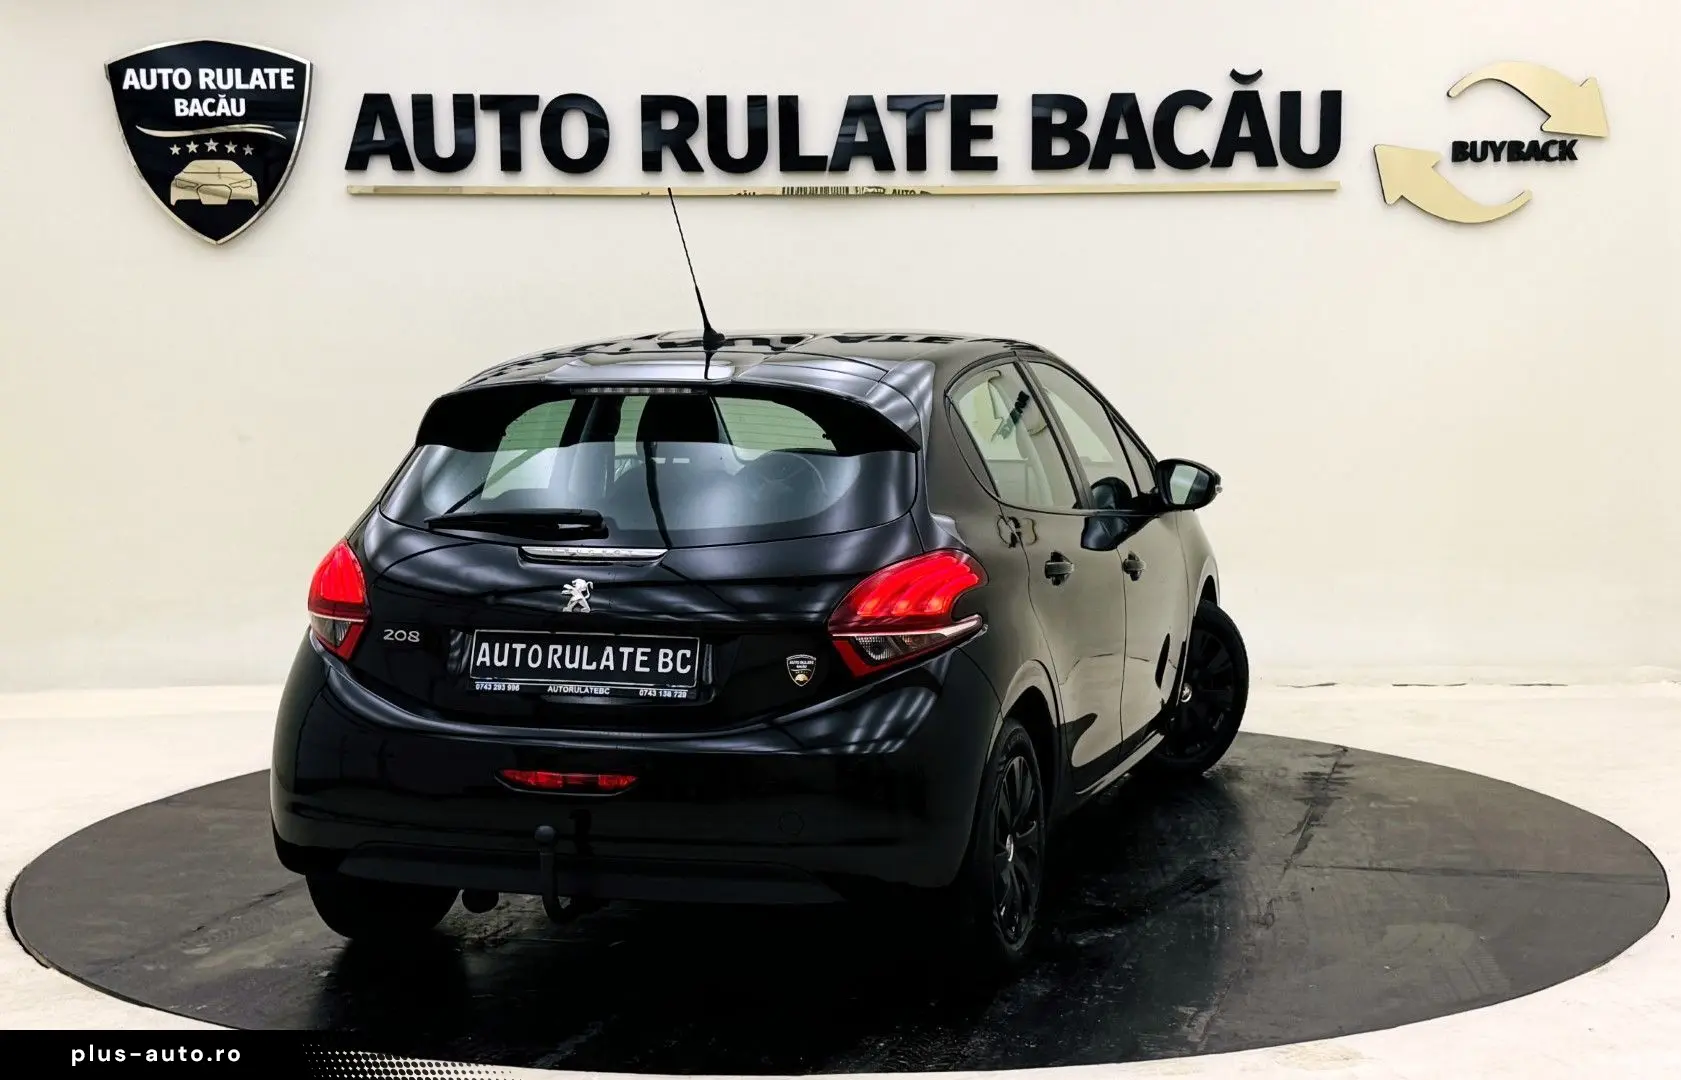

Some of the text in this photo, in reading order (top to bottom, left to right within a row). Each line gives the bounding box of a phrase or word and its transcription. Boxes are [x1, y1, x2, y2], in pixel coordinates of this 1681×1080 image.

[123, 68, 295, 91] AUTO RULATE
[174, 94, 246, 117] BACĂU
[345, 69, 1343, 174] AUTO RULATE BACĂU
[1451, 139, 1578, 162] BUYBACK
[383, 628, 420, 642] 208
[657, 648, 692, 674] BC
[547, 685, 610, 695] AUTORULATEBC
[639, 689, 657, 697] 0743
